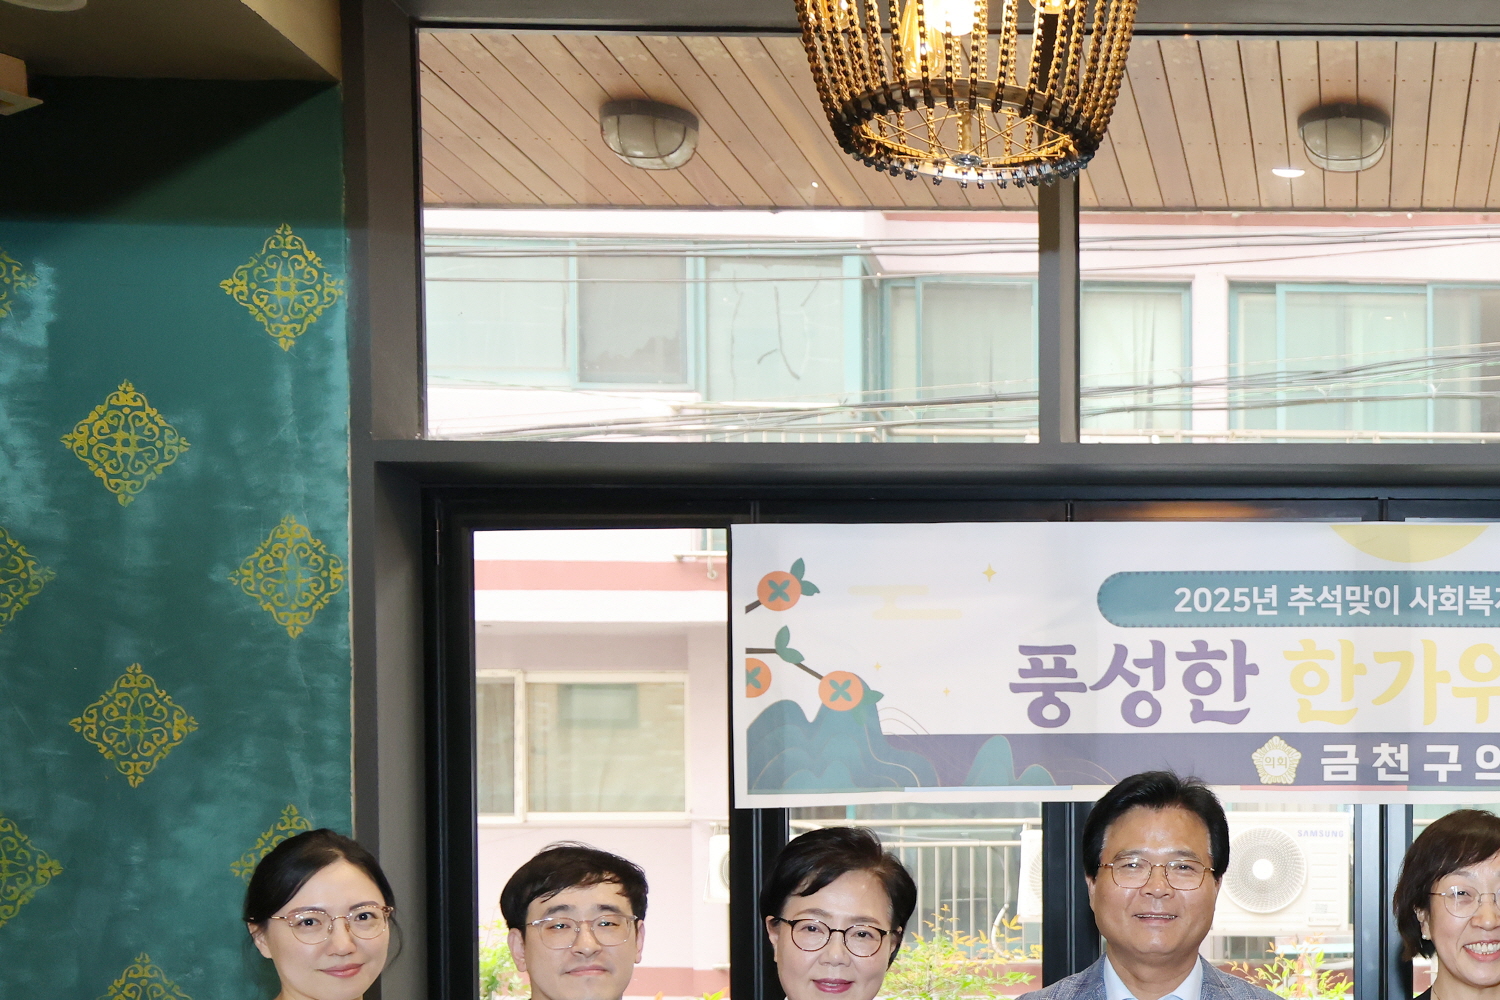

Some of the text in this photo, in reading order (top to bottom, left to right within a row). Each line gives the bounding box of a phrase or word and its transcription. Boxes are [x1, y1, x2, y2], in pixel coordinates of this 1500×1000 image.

[1173, 584, 1278, 615] 2025년
[1287, 584, 1400, 616] 추석맞이
[1008, 639, 1260, 729] 풍성한
[1297, 829, 1344, 838] SAMSUNG
